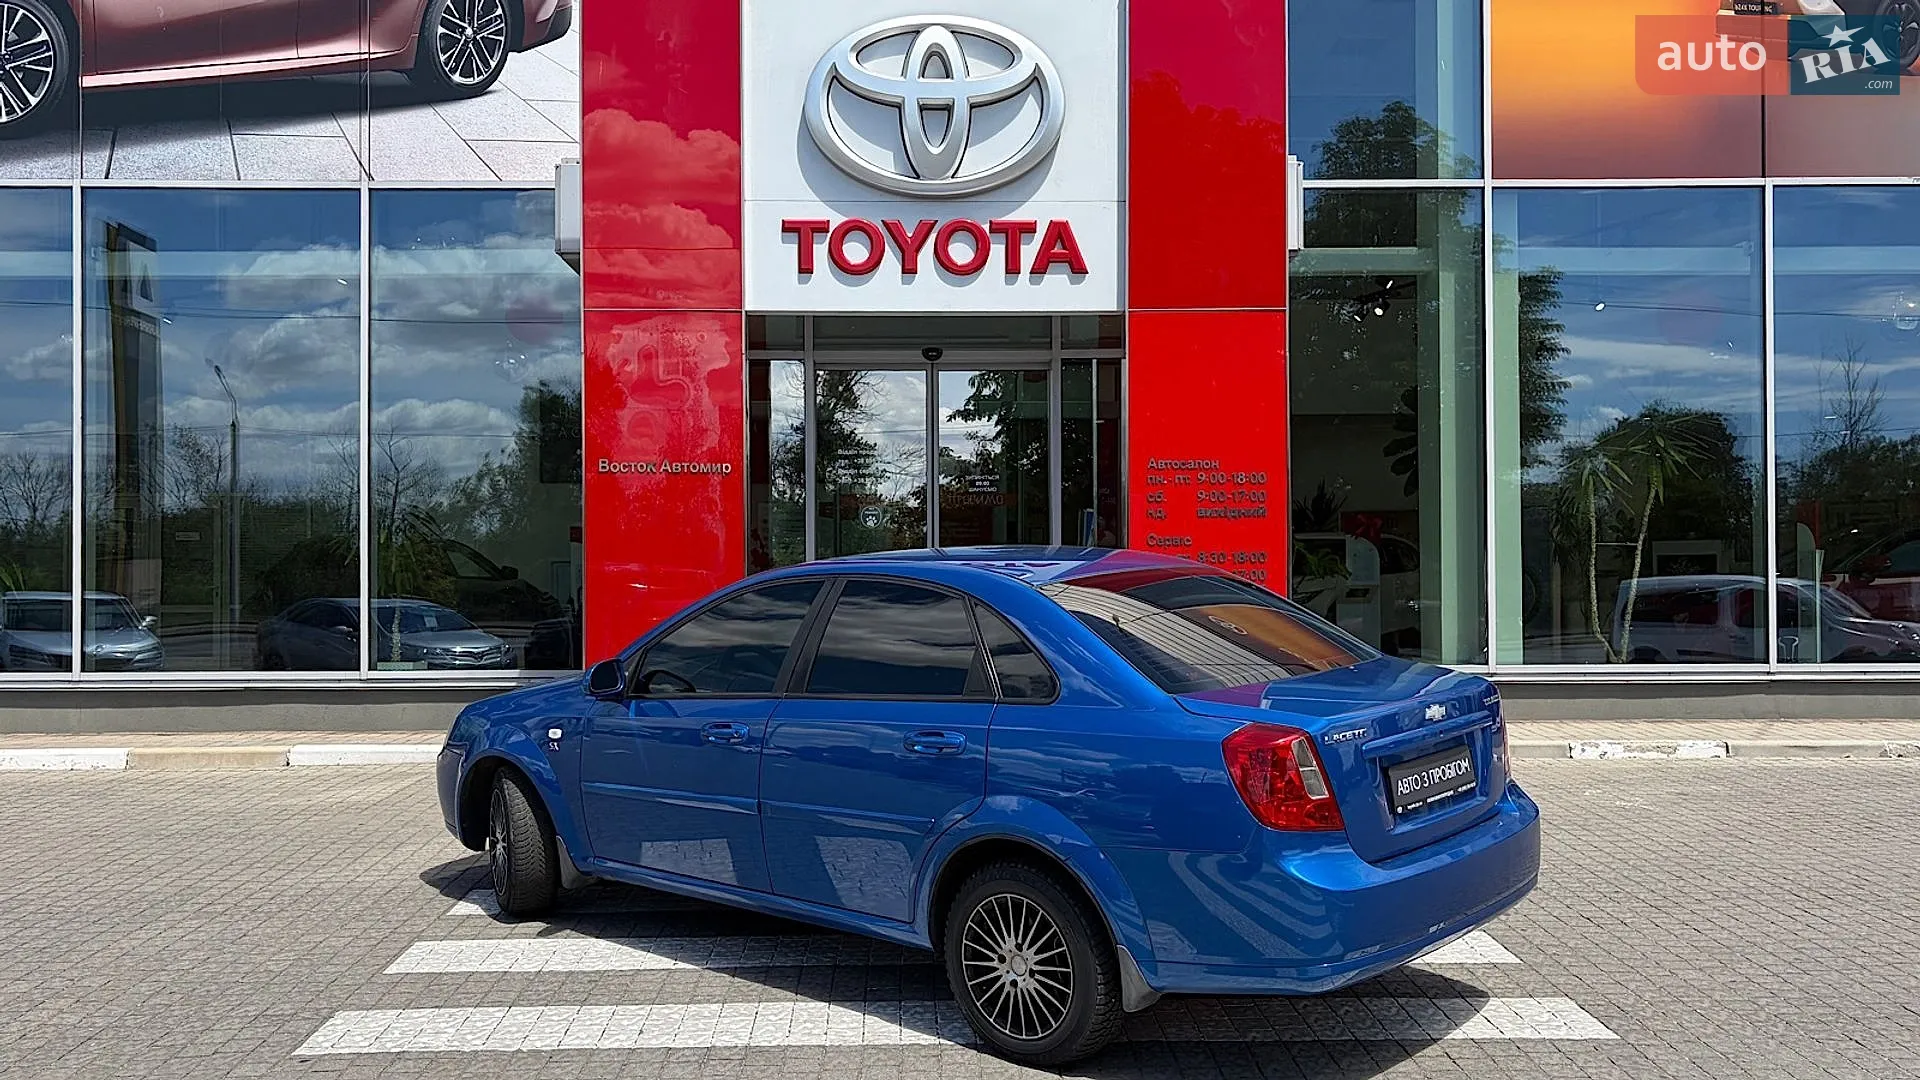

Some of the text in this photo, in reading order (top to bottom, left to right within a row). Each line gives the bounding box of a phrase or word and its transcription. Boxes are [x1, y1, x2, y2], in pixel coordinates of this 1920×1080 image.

[782, 218, 1089, 276] TOYOTA
[598, 458, 732, 476] Восток Автомир
[1147, 457, 1219, 470] Автосалон
[1197, 471, 1268, 484] 9:00-18:00
[1147, 490, 1167, 501] сб.
[1147, 533, 1193, 548] Сервіс
[1397, 757, 1471, 796] АВТО З ПРОБІГОМ
